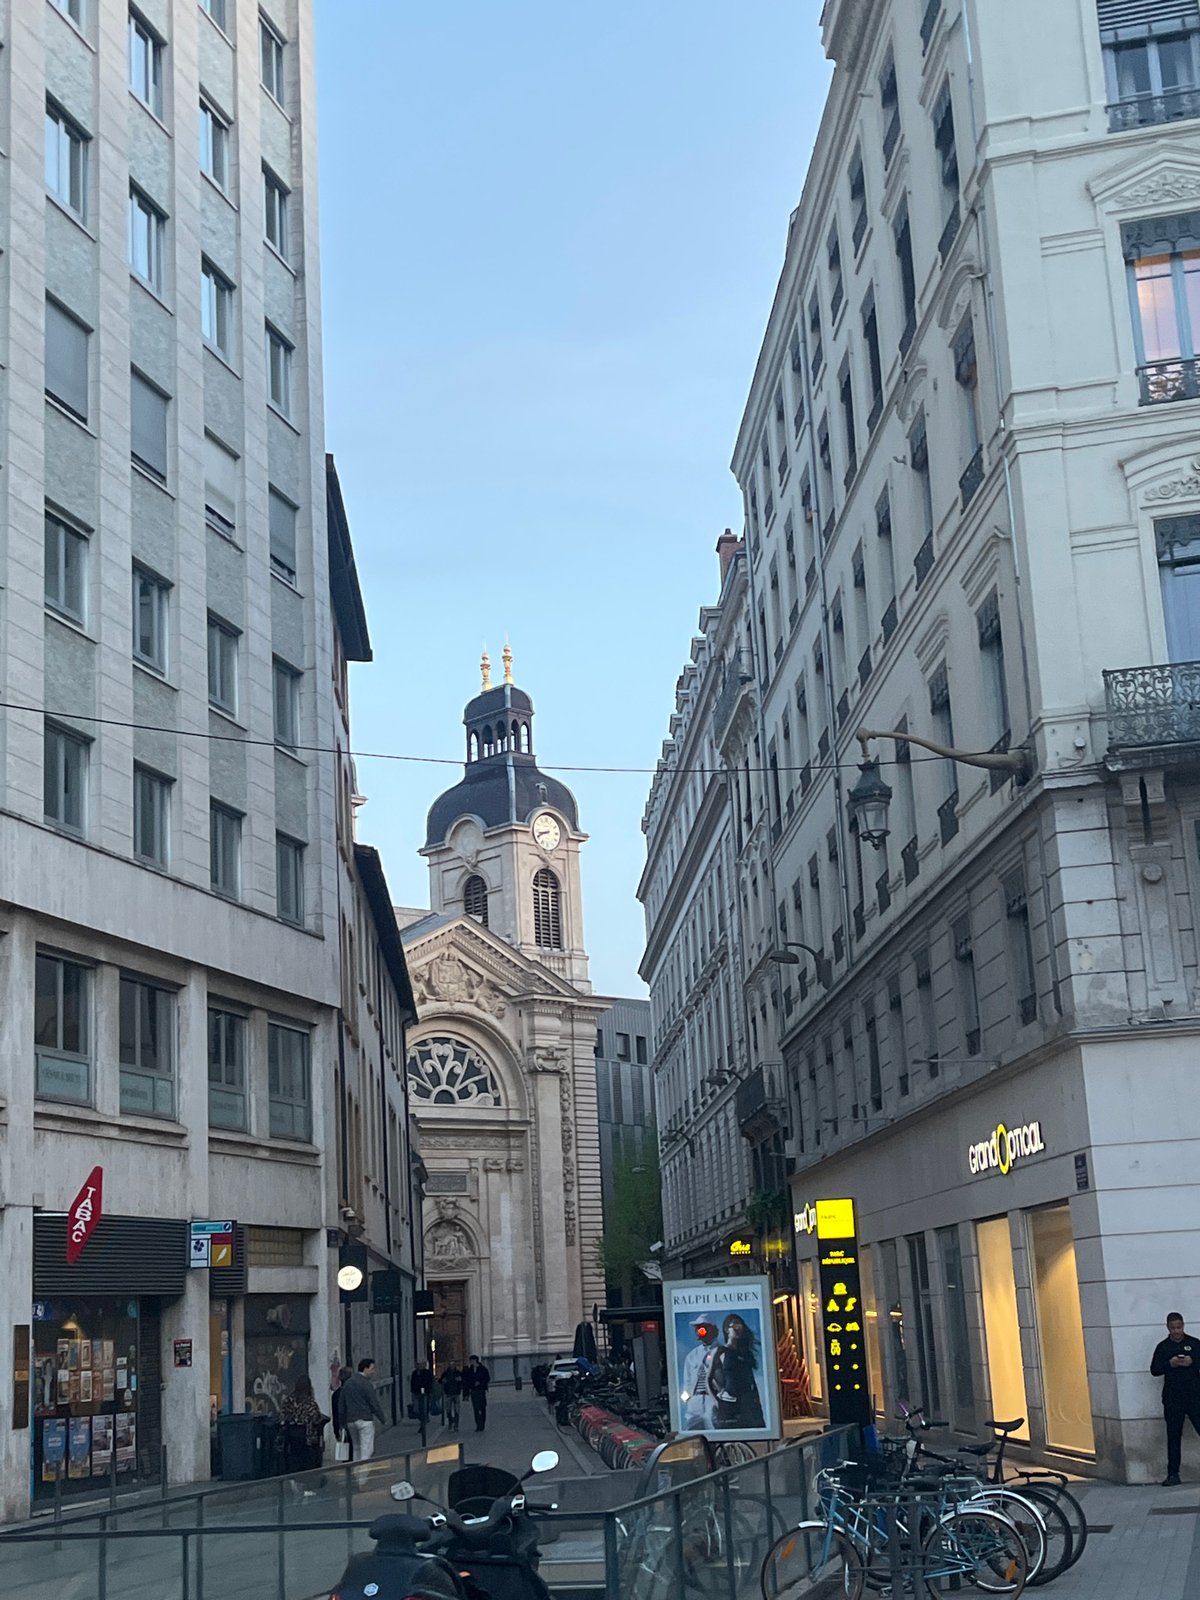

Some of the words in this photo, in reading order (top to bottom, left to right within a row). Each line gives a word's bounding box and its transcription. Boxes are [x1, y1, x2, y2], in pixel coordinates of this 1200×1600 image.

[71, 1186, 97, 1243] TABAC
[673, 1294, 710, 1306] RALPH
[714, 1291, 759, 1304] LAUREN
